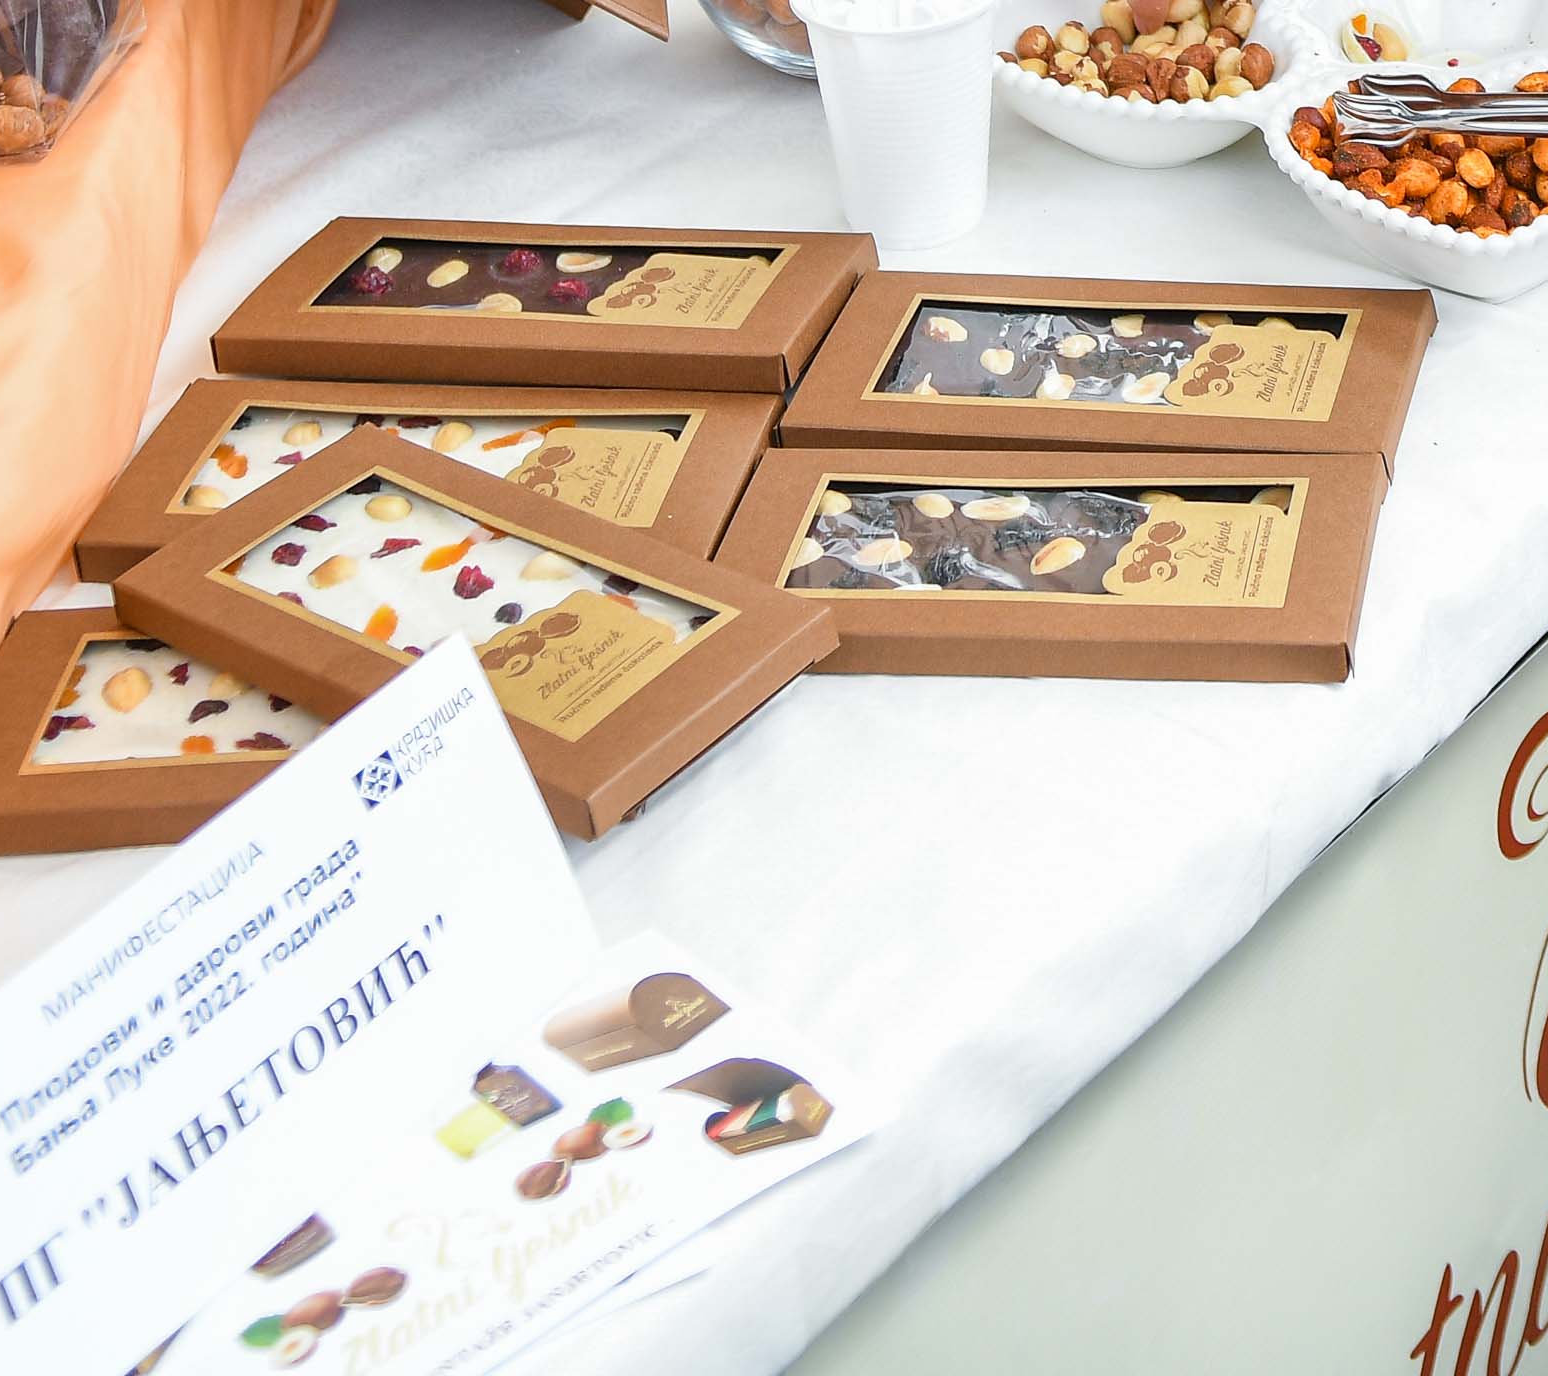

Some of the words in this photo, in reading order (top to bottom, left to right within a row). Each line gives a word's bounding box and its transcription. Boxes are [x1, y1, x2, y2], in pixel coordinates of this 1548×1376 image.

[1256, 372, 1277, 402] Zlatni
[1203, 552, 1224, 587] Zlatni
[536, 661, 580, 700] Zlatni
[41, 840, 265, 1024] МАНИФЕСТАЦИЈА
[148, 993, 167, 1018] и
[175, 904, 276, 1000] дарови
[282, 839, 360, 910] града
[9, 1098, 100, 1175] Бања
[104, 1034, 176, 1102] Луке
[183, 971, 254, 1039] 2022.
